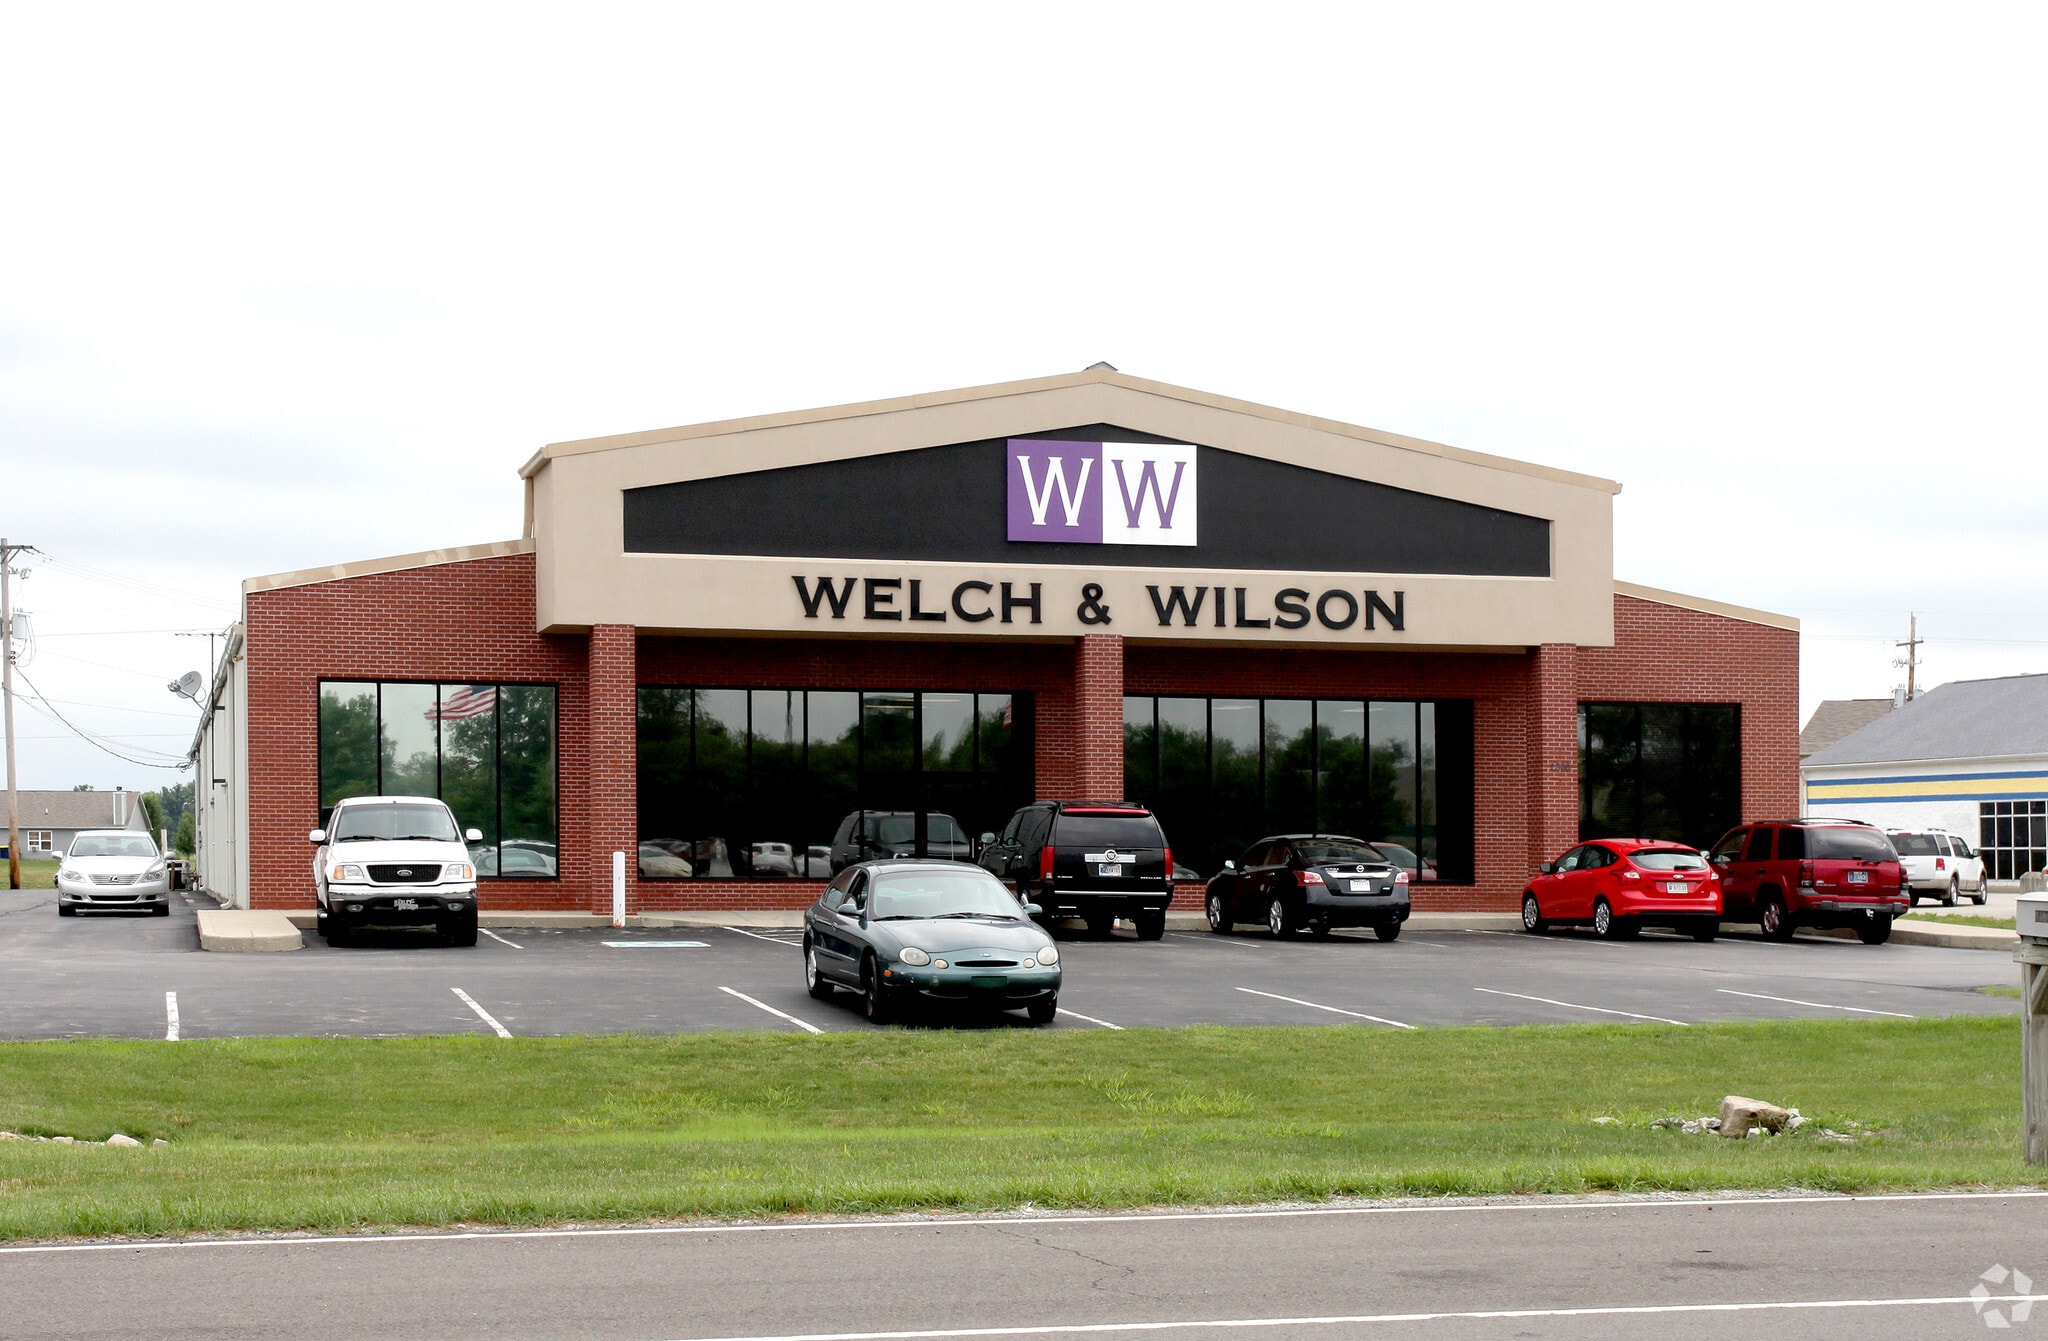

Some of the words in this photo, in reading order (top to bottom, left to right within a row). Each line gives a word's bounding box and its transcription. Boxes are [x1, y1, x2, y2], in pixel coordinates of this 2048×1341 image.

[791, 575, 1043, 625] WELCH
[1077, 582, 1113, 626] &
[1146, 585, 1406, 632] WILSON
